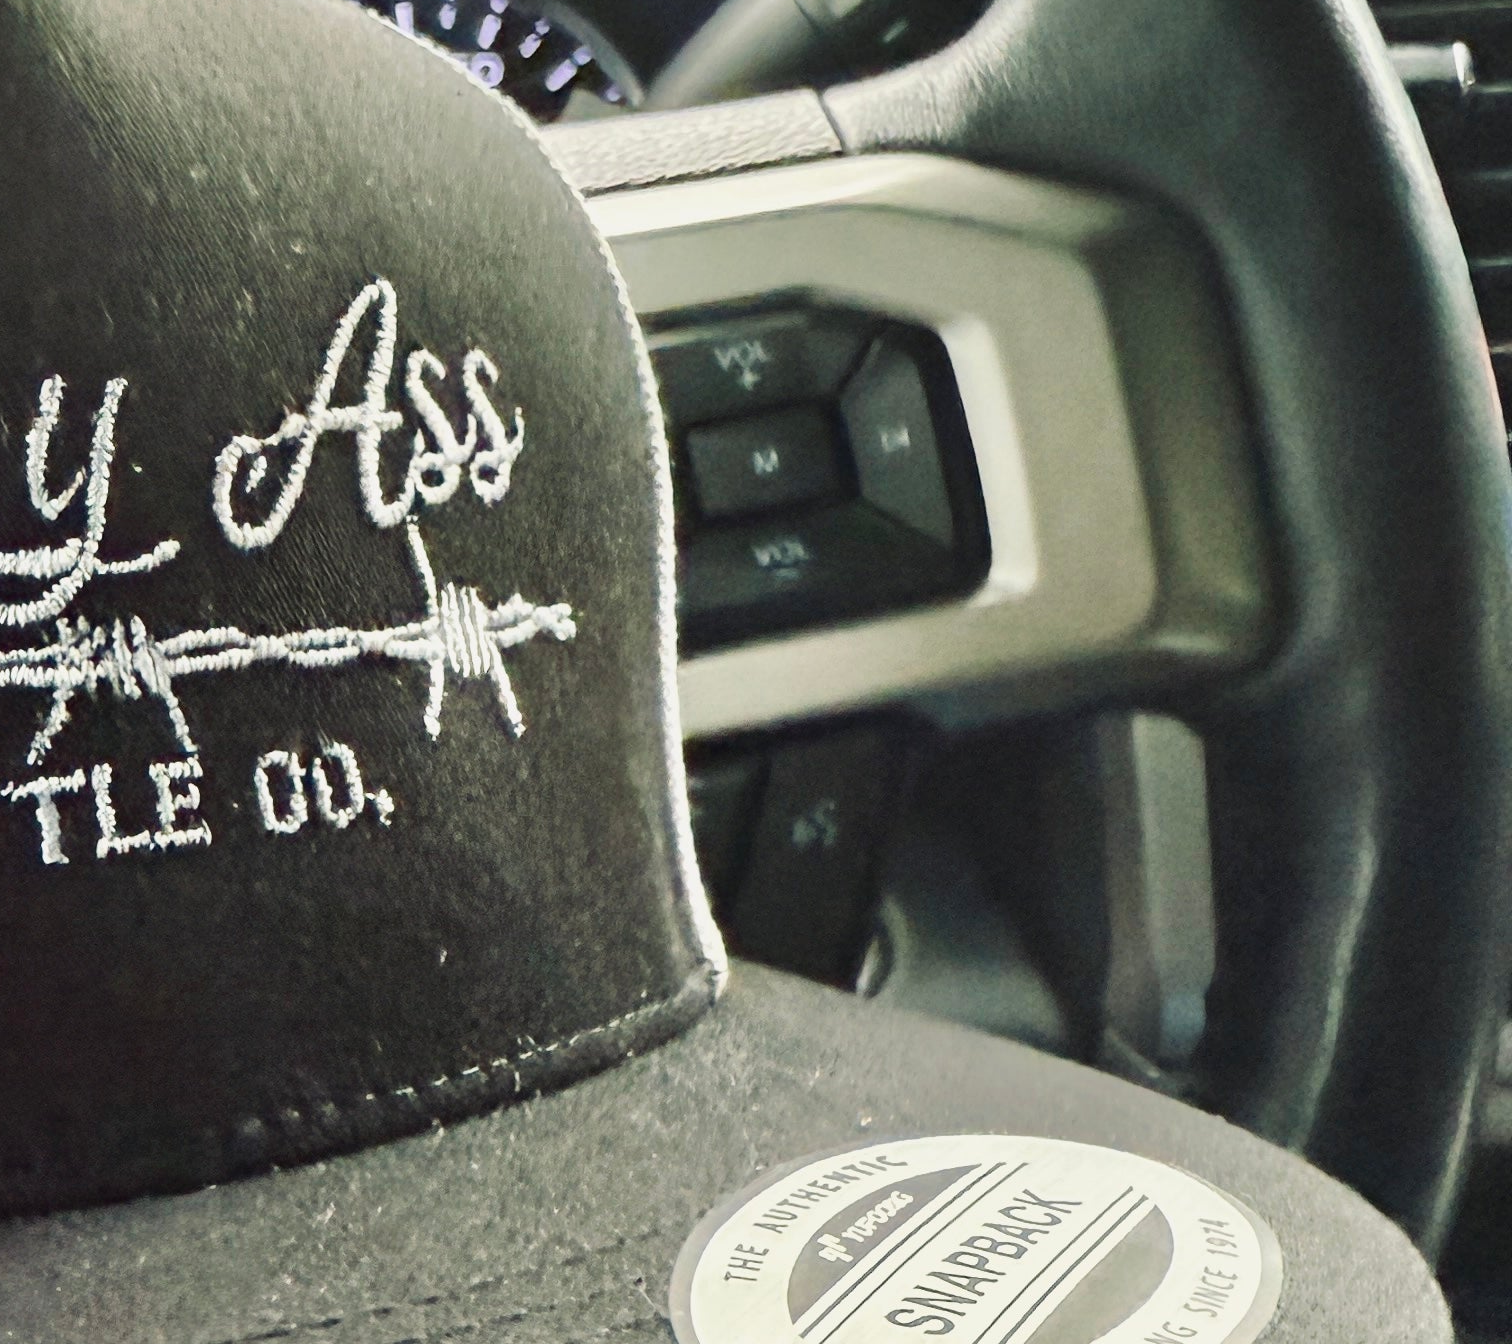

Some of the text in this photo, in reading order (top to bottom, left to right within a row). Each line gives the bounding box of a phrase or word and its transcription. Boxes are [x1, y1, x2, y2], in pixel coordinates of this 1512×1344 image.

[215, 278, 524, 546] Ass
[255, 742, 394, 833] CO.
[724, 1155, 908, 1281] THE AUTHENTIC
[884, 1188, 1083, 1335] SNAPBACK
[1183, 1266, 1238, 1318] SINCE
